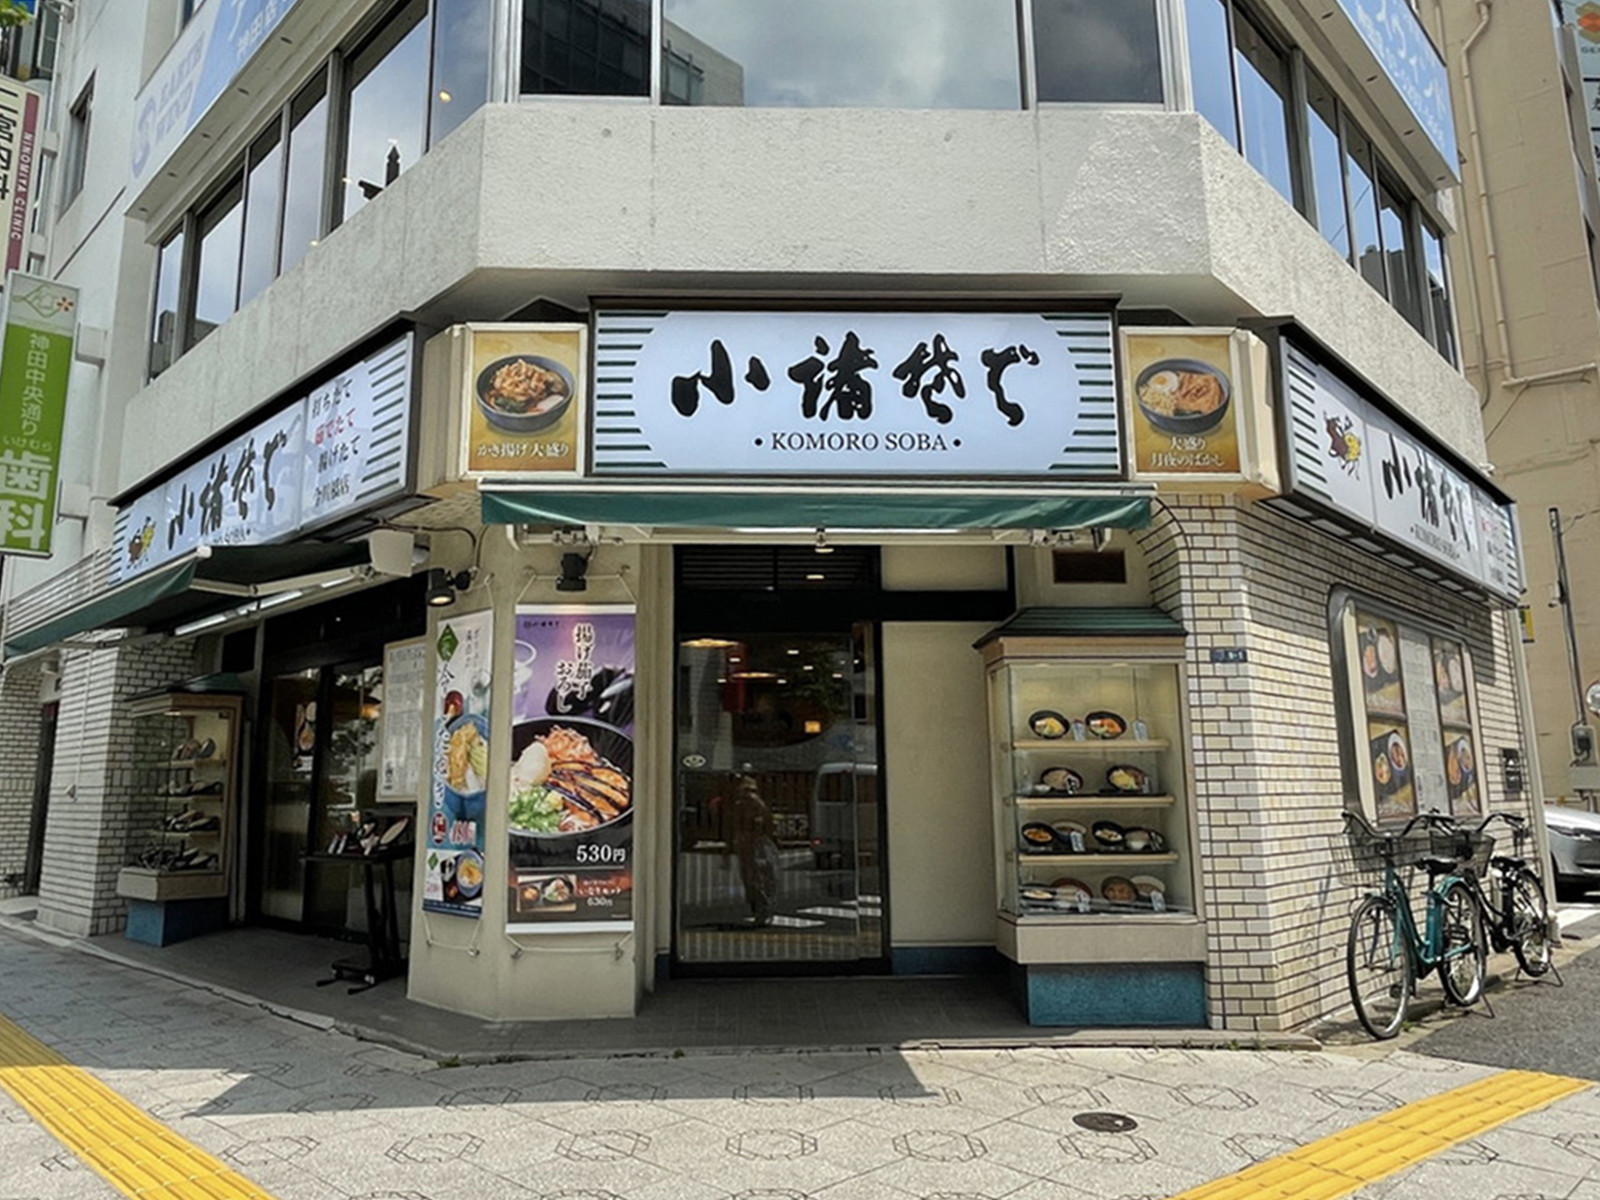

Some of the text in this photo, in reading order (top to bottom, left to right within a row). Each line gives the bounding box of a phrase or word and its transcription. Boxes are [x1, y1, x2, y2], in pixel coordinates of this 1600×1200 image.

[10, 132, 34, 242] NINOMIYA CLINIC
[20, 333, 50, 436] 神田中央通り
[771, 432, 947, 451] KOMORO SOBA
[555, 659, 573, 714] おろし
[575, 844, 626, 863] 530円
